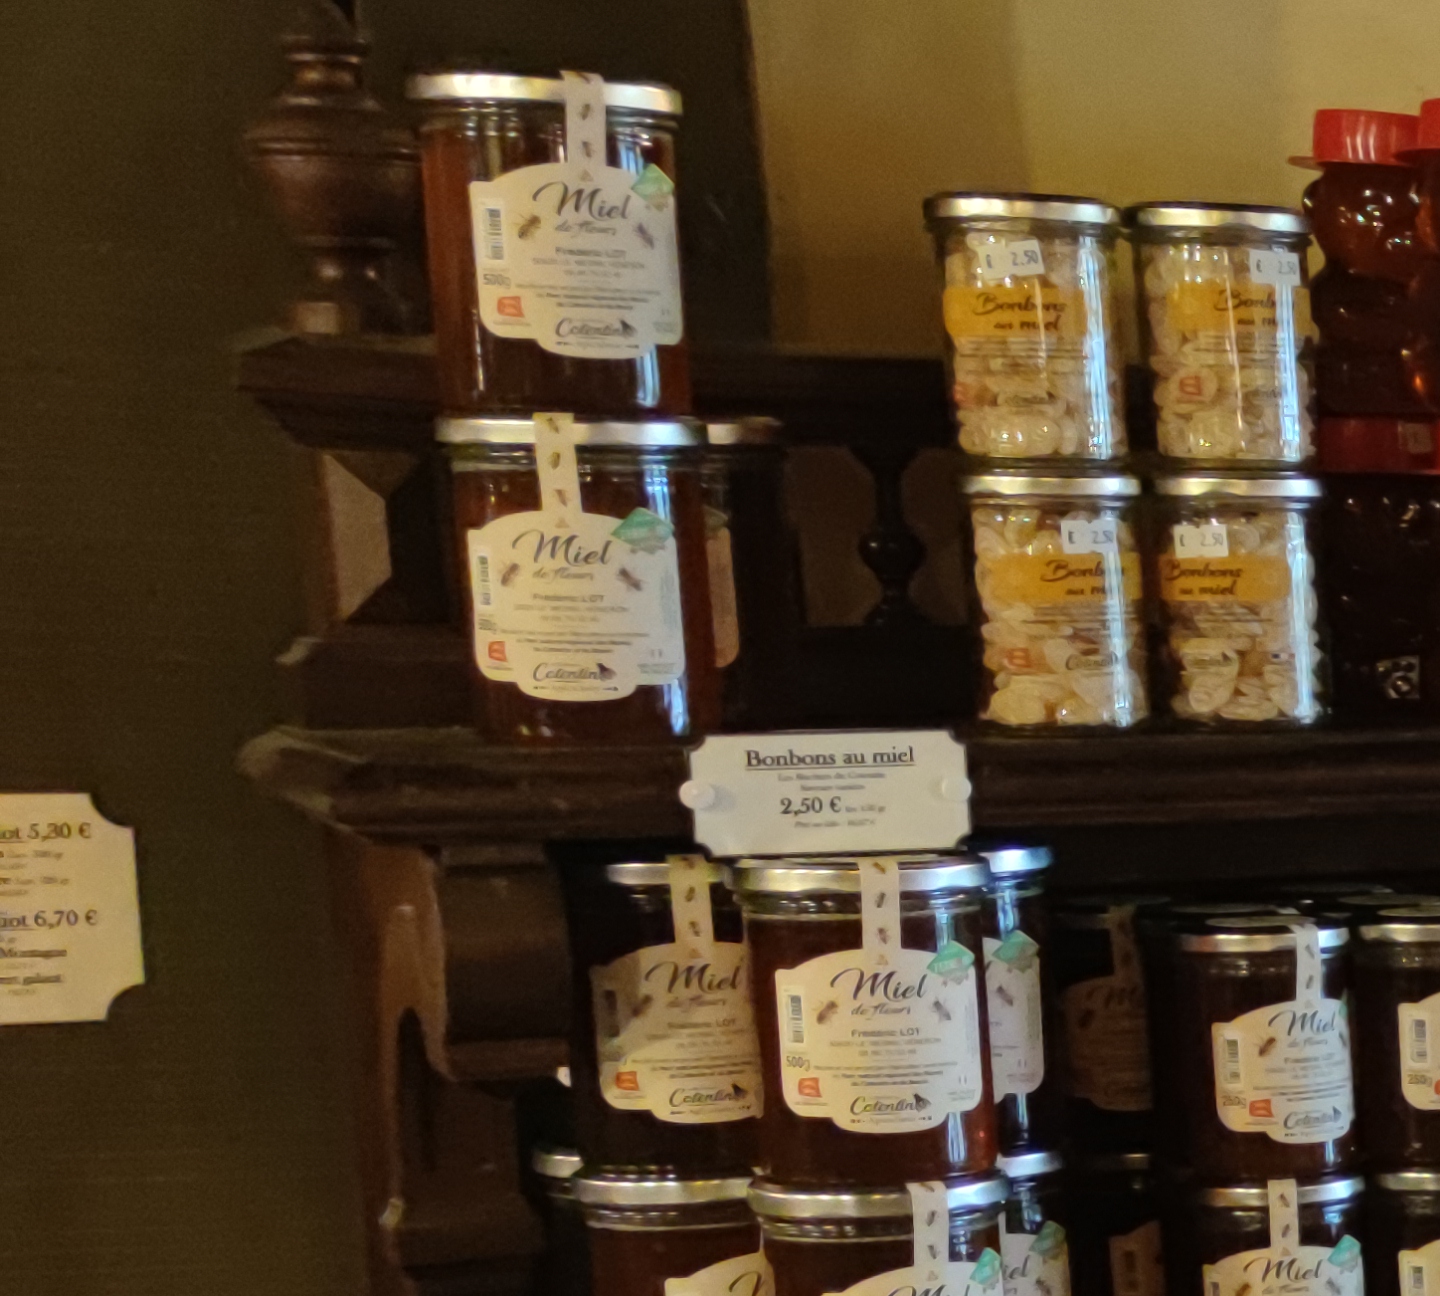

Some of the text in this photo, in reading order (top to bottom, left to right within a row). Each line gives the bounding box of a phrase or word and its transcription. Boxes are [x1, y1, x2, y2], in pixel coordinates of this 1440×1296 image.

[533, 181, 631, 221] Miel
[972, 291, 1068, 315] Bonbons
[1017, 314, 1063, 334] miel
[512, 529, 612, 567] Miel
[1164, 560, 1243, 581] Bonbons
[1198, 577, 1237, 597] miel
[746, 746, 915, 768] Bonbons au miel
[780, 797, 823, 817] 2,50
[830, 796, 841, 813] €
[79, 822, 92, 839] €
[33, 909, 99, 929] 6,70 €
[646, 962, 742, 993] Miel
[830, 969, 928, 1000] Miel
[851, 1002, 911, 1020] de fleurs
[1269, 1010, 1336, 1034] Miel
[785, 1056, 811, 1070] 500g
[850, 1094, 920, 1115] Cotentin
[1243, 1257, 1323, 1281] Miel
